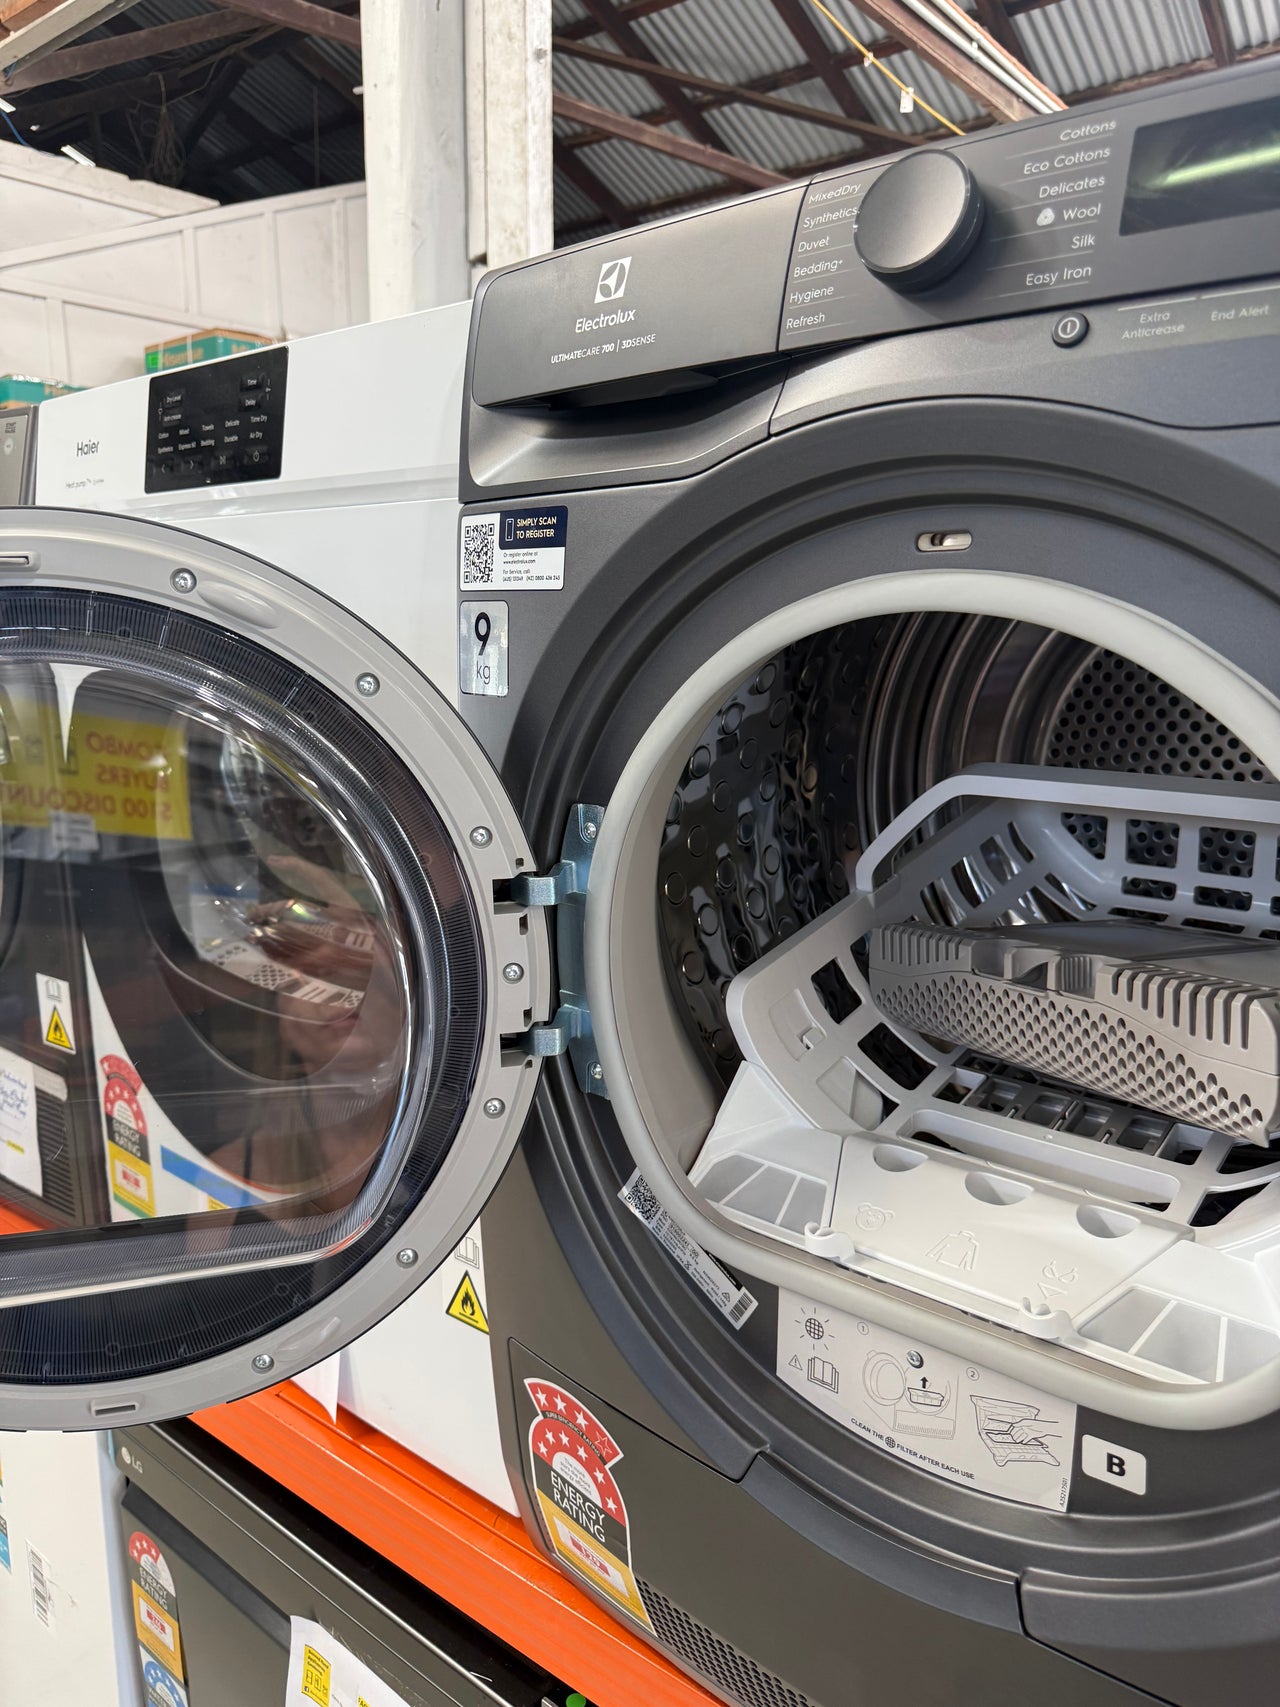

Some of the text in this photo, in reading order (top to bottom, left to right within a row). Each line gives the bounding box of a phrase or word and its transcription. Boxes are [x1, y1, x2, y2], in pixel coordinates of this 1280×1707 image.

[1060, 119, 1117, 141] Cottons
[1023, 147, 1111, 175] Eco Cottons
[808, 183, 861, 204] MixedDry
[1039, 176, 1105, 198] Delicates
[803, 206, 858, 229] Synthetics
[1063, 203, 1101, 222] Wool
[798, 236, 830, 252] Duvet
[1071, 234, 1096, 249] Silk
[1025, 266, 1092, 286] Easy Iron
[789, 286, 834, 304] Hygiene
[575, 309, 636, 333] Electrolux
[786, 312, 826, 330] Refresh
[1139, 312, 1171, 324] Extra
[1211, 305, 1270, 321] End Alert
[1121, 323, 1186, 340] Anticrease
[551, 334, 656, 364] ULTIMATECARE 700 3DSENSE
[76, 440, 100, 457] Haier
[517, 516, 557, 527] SIMPLY SCAN
[516, 529, 555, 539] TO REGISTER
[475, 612, 491, 656] 9
[476, 660, 491, 685] kg
[851, 1418, 975, 1480] CLEAN THE FILTER AFTER EACH USE
[131, 1456, 143, 1474] LG
[1106, 1452, 1126, 1477] B
[551, 1470, 605, 1526] ENERGY
[553, 1488, 605, 1543] RATING
